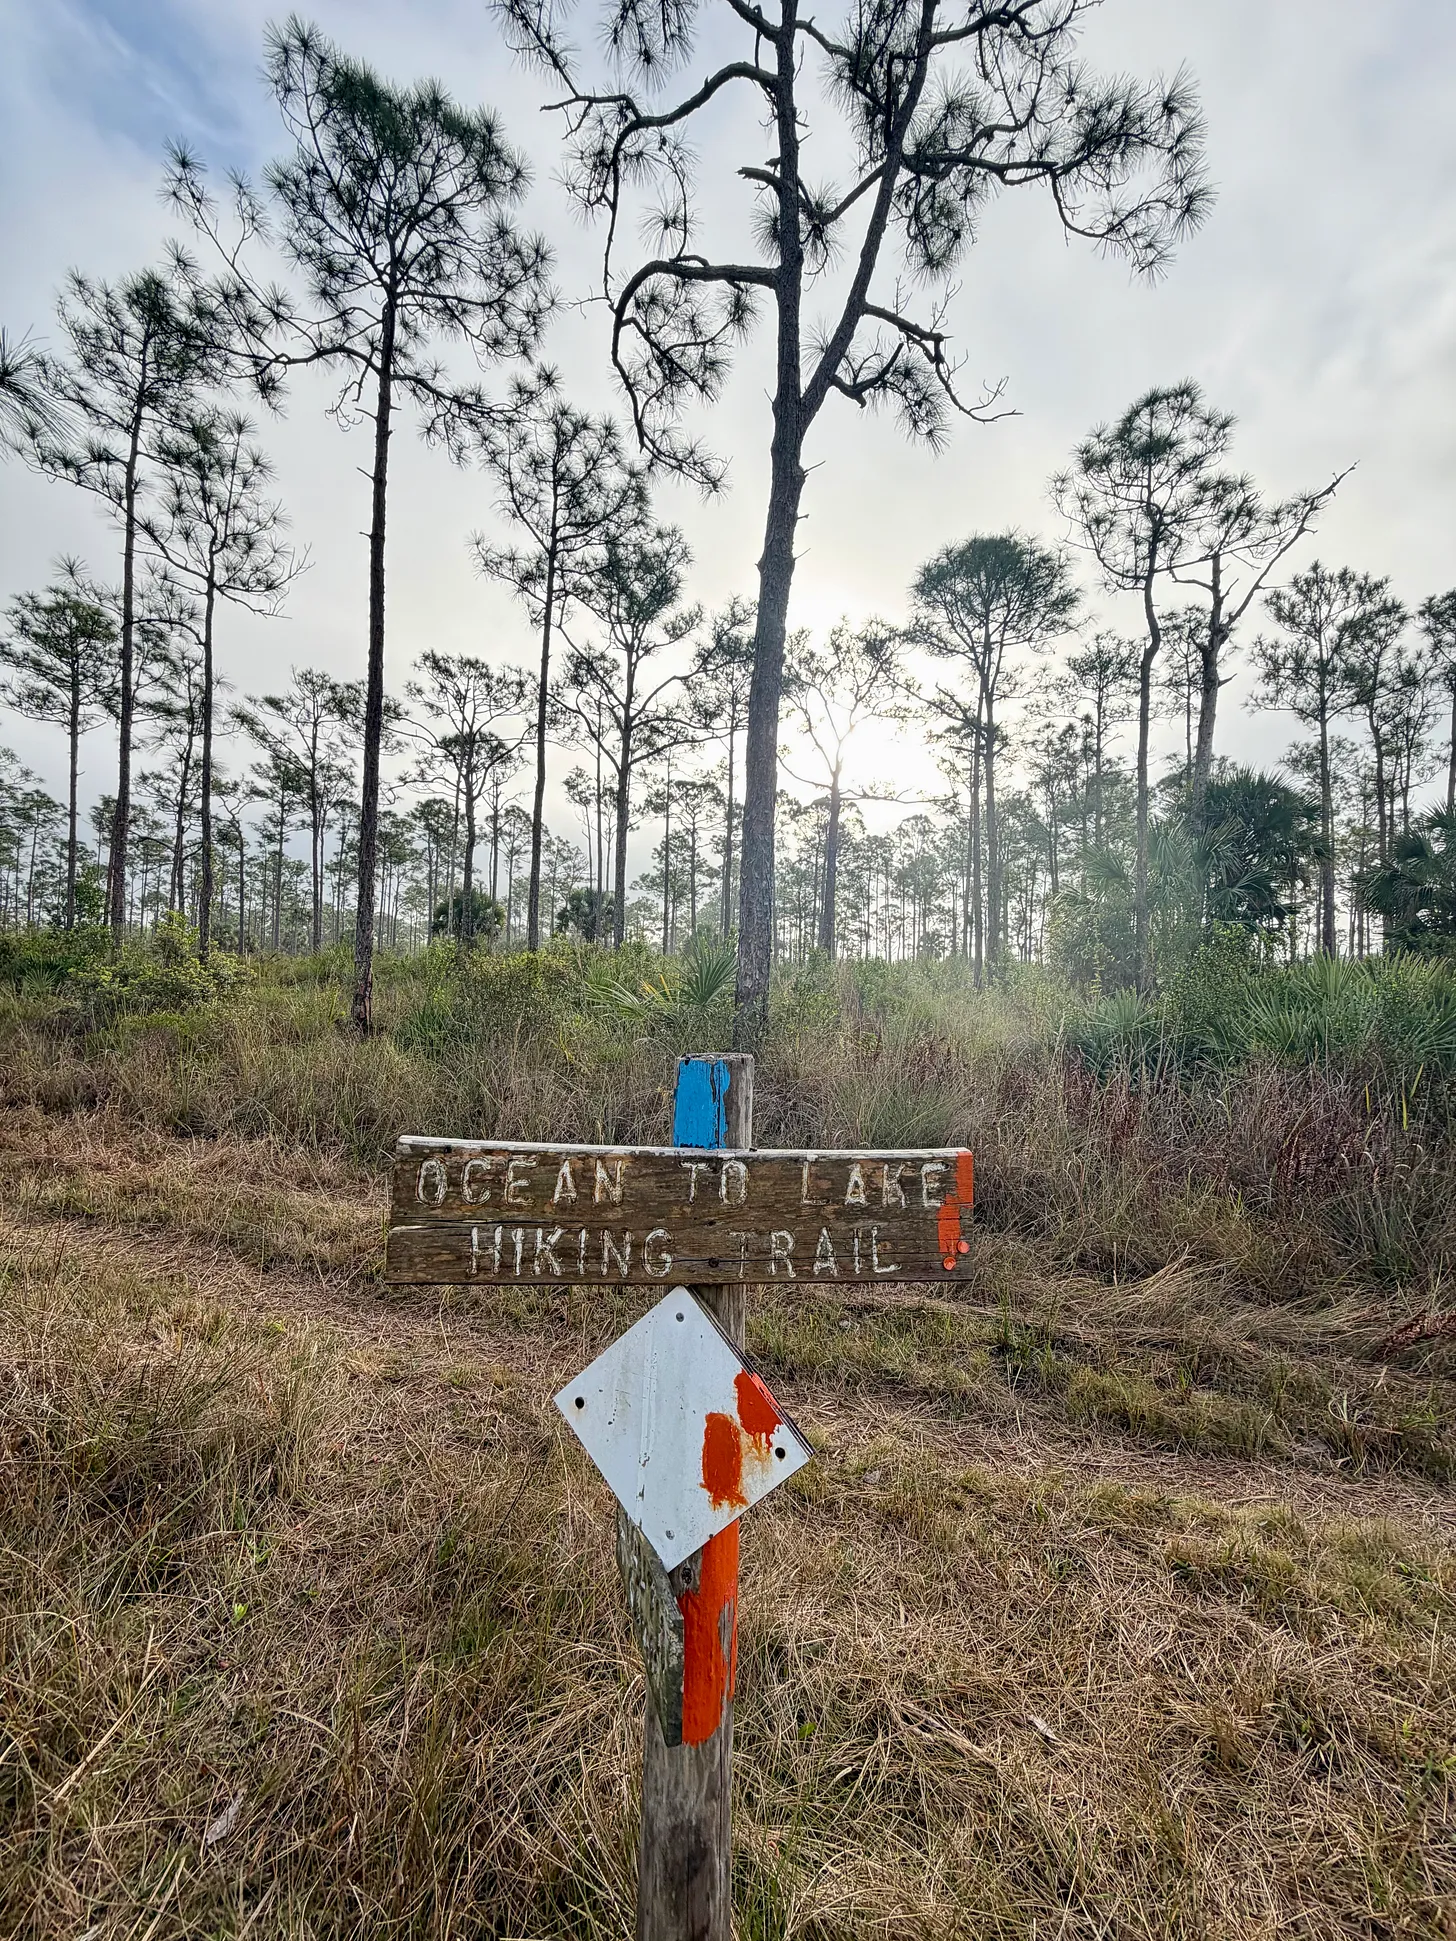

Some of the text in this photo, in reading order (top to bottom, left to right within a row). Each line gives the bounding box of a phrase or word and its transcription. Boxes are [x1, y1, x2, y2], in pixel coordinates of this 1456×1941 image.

[416, 1156, 950, 1208] OCEAN TO LAKE
[469, 1225, 901, 1278] HIKING TRAIL
